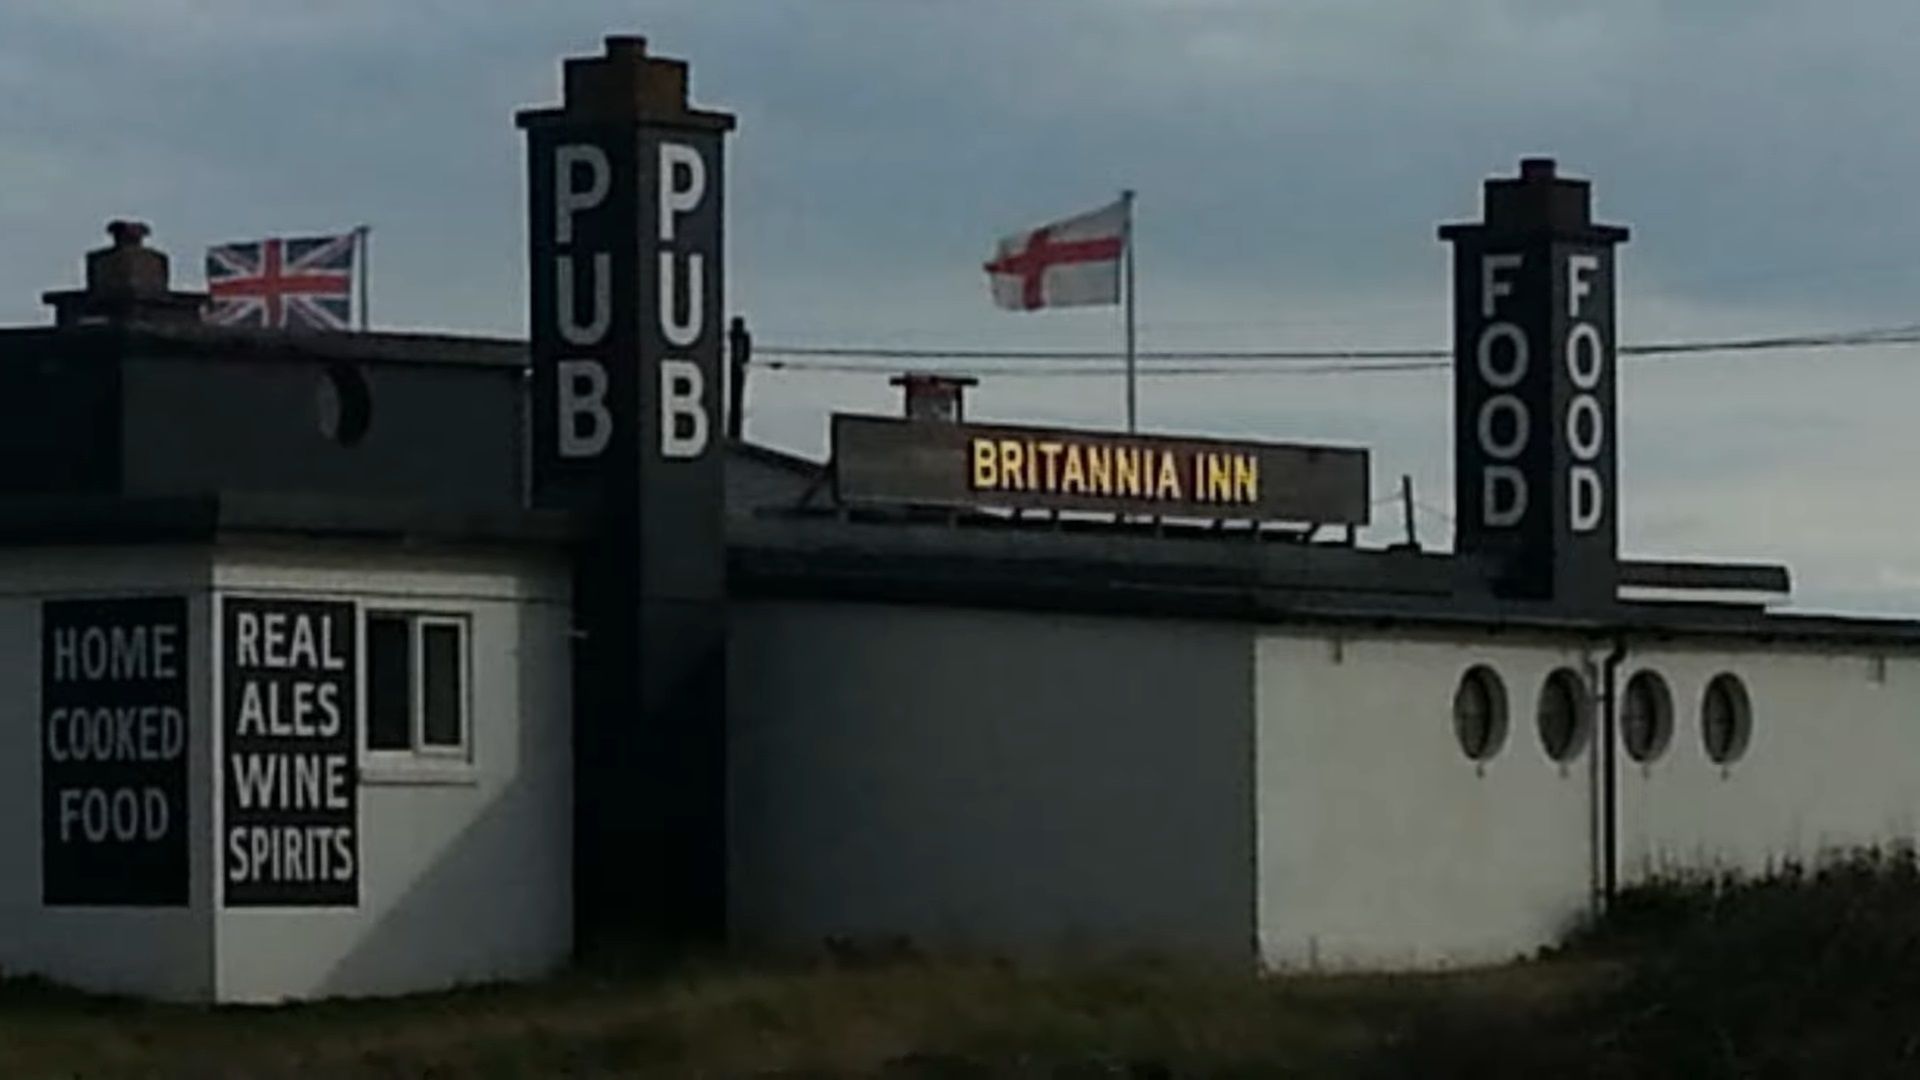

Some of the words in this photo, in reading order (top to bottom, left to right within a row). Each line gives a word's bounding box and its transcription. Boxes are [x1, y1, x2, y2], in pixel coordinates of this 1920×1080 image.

[555, 143, 612, 457] PUB
[658, 142, 708, 457] PUB
[1477, 254, 1529, 527] FOOD
[1566, 255, 1602, 531] FOOD
[972, 438, 1182, 499] BRITANNIA
[1196, 452, 1259, 503] INN
[53, 625, 178, 681] HOME
[237, 611, 346, 671] REAL
[48, 706, 184, 761] COOKED
[236, 682, 341, 737] ALES
[233, 753, 349, 809] WINE
[60, 787, 169, 843] FOOD
[229, 826, 354, 883] SPIRITS
